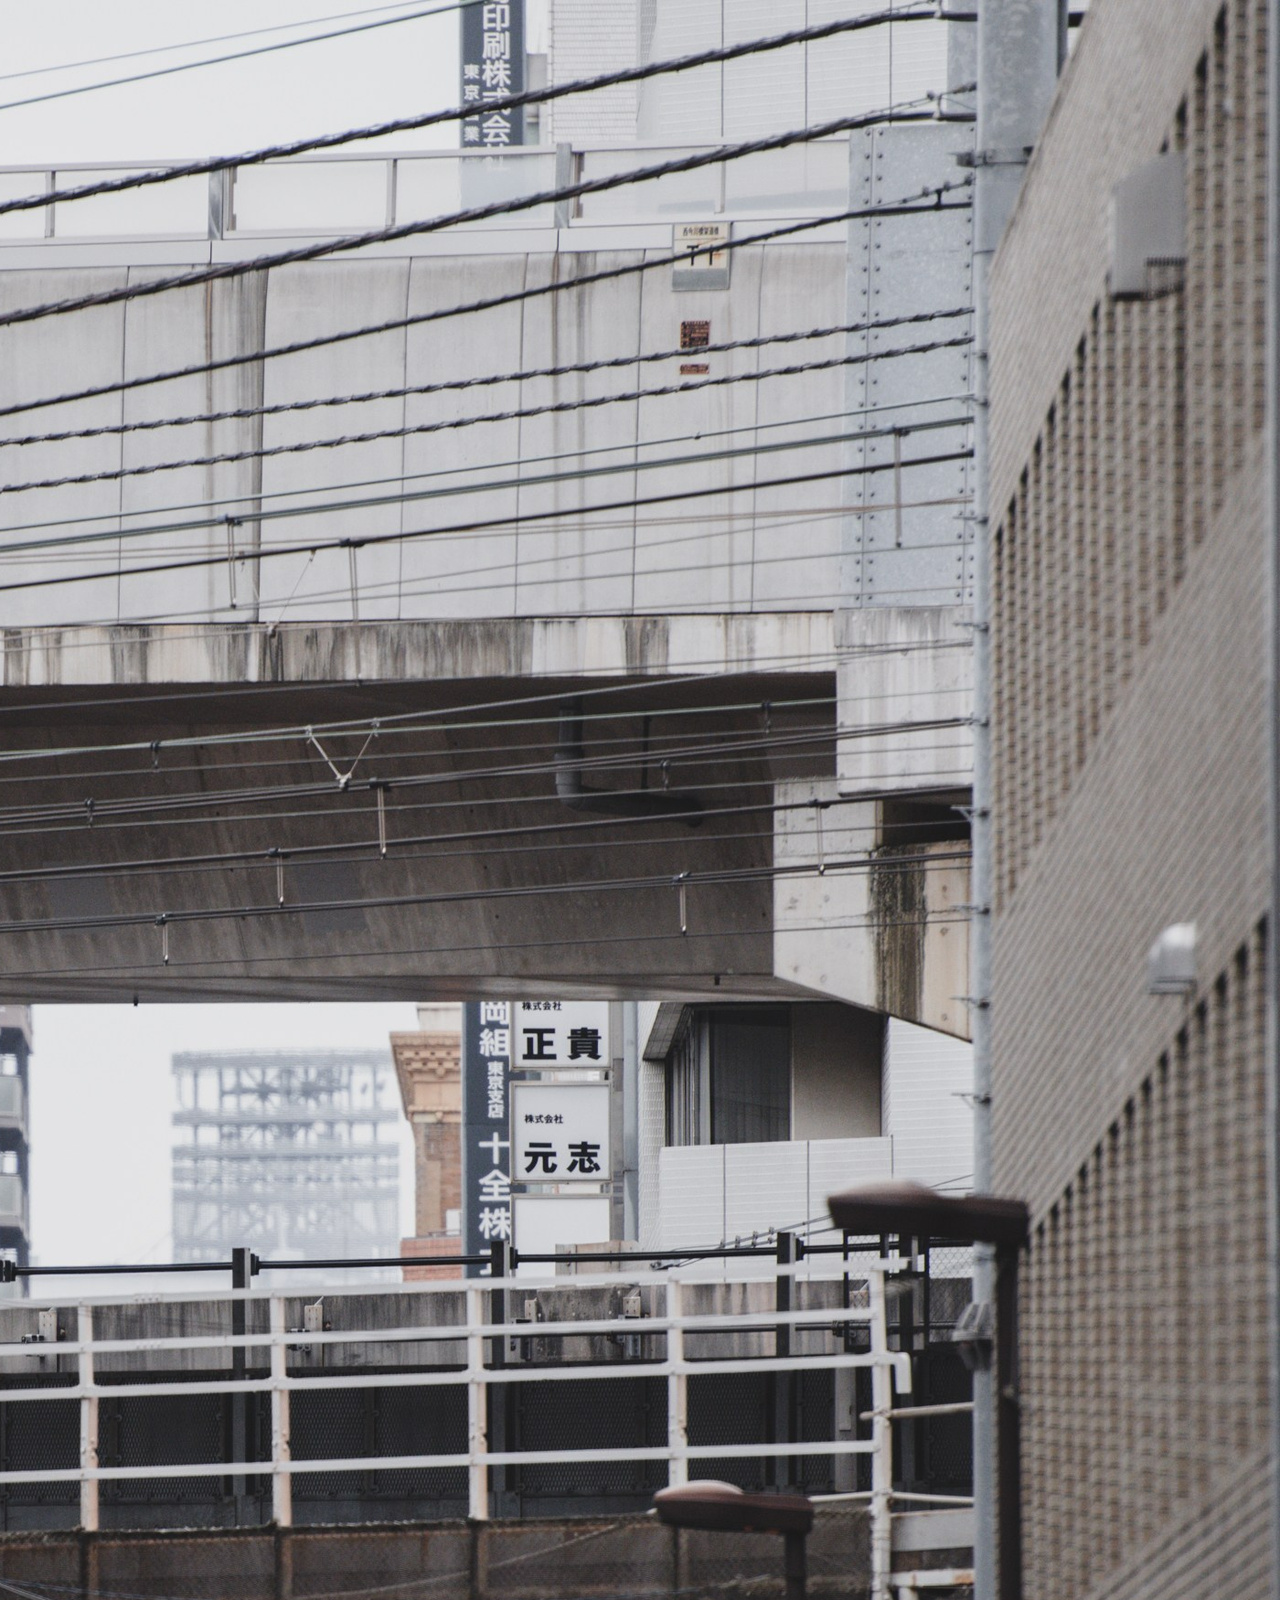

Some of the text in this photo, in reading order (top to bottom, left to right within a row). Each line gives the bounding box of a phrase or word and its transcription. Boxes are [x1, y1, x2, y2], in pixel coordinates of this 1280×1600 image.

[522, 1002, 562, 1011] 株式会社
[522, 1027, 603, 1061] 正貴
[487, 1061, 505, 1119] 東京支店
[524, 1114, 563, 1125] 株式会社
[524, 1141, 602, 1174] 元志
